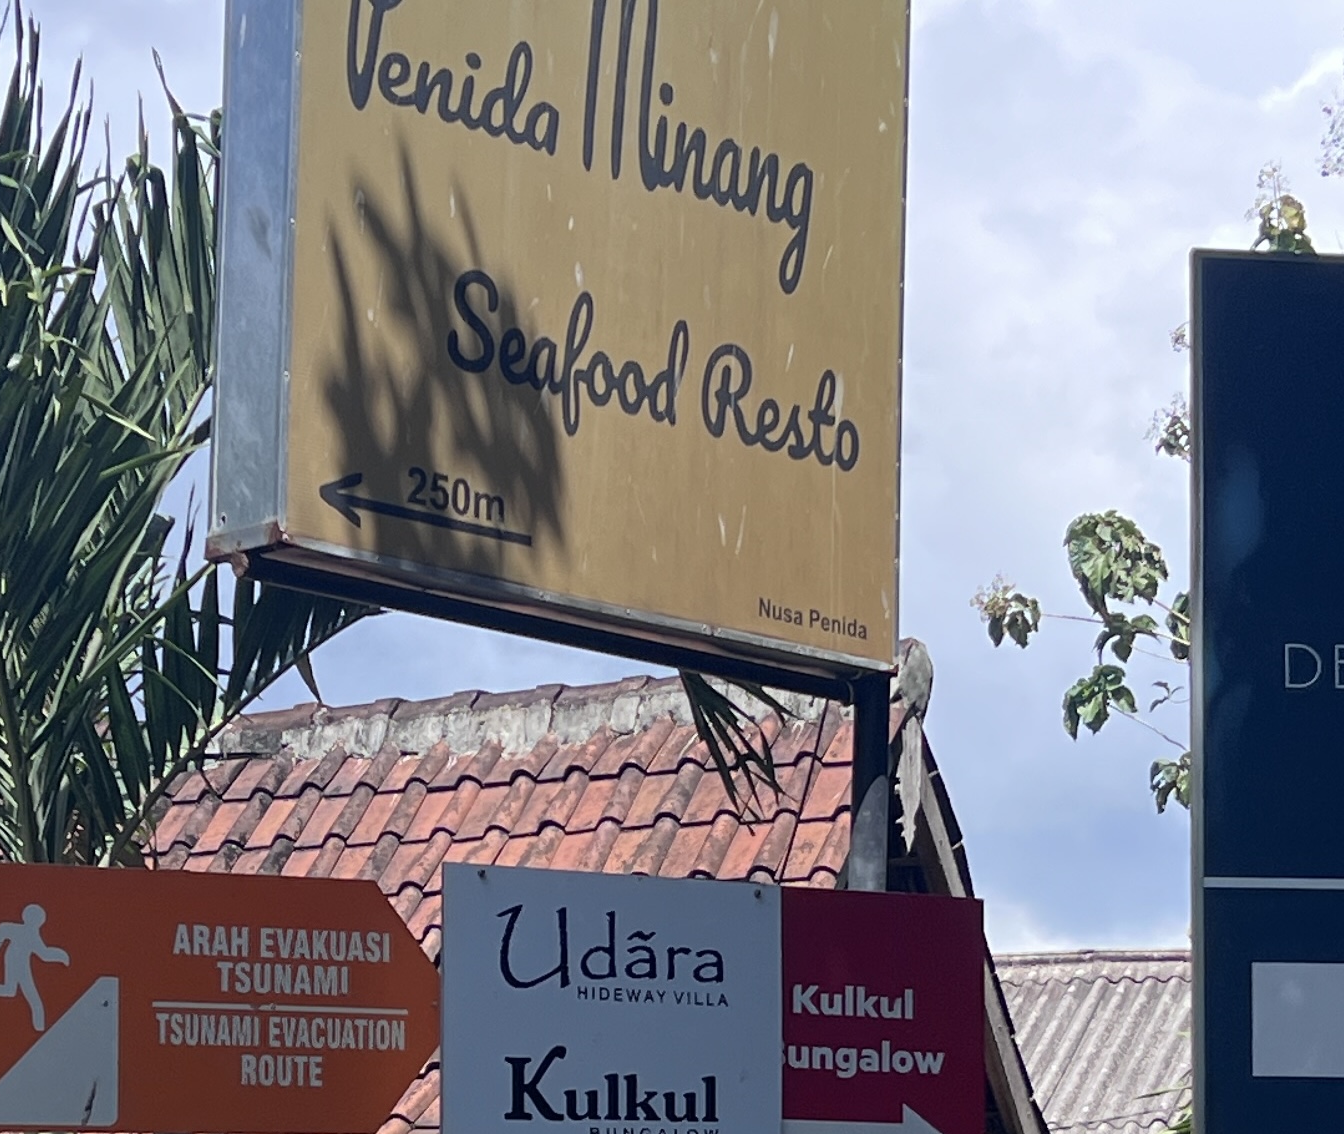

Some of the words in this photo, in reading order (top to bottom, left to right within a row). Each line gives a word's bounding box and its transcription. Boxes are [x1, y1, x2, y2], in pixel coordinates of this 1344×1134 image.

[446, 269, 688, 436] Seafood
[702, 343, 859, 472] Resto
[406, 466, 505, 523] 250m
[758, 597, 803, 627] Nusa
[809, 601, 868, 640] Penida
[173, 924, 249, 957] ARAH
[260, 927, 391, 962] EVAKUASI
[217, 962, 349, 996] TSUNAMI
[577, 986, 666, 1004] HIDEWAY
[673, 991, 728, 1007] VILLA
[792, 984, 914, 1020] Kulkul
[156, 1013, 260, 1046] TSUNAMI
[269, 1017, 406, 1050] EVACUATION
[241, 1055, 323, 1088] ROUTE
[782, 1040, 945, 1078] ungalow
[504, 1045, 719, 1123] Kulkul
